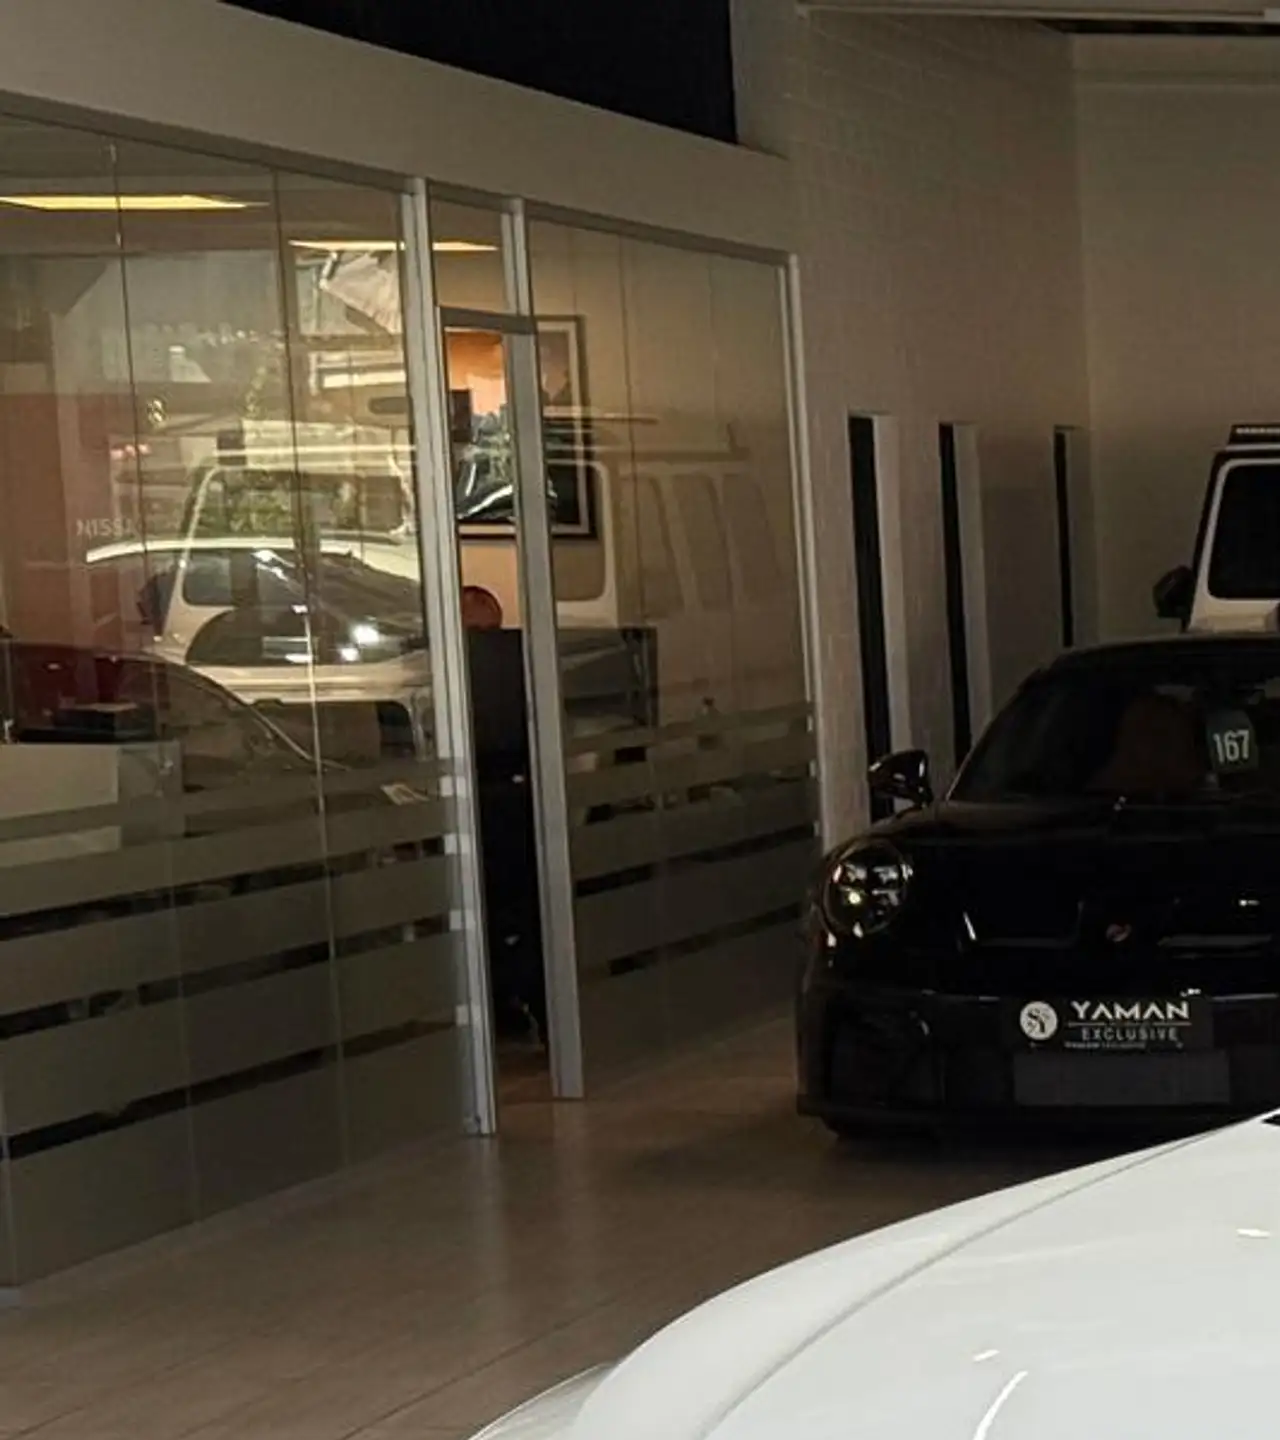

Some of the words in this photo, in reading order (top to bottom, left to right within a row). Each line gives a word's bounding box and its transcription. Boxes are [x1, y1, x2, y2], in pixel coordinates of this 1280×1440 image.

[1213, 729, 1249, 763] 167
[1071, 1000, 1191, 1020] YAMAN
[1081, 1026, 1179, 1041] EXCLUSIVE
